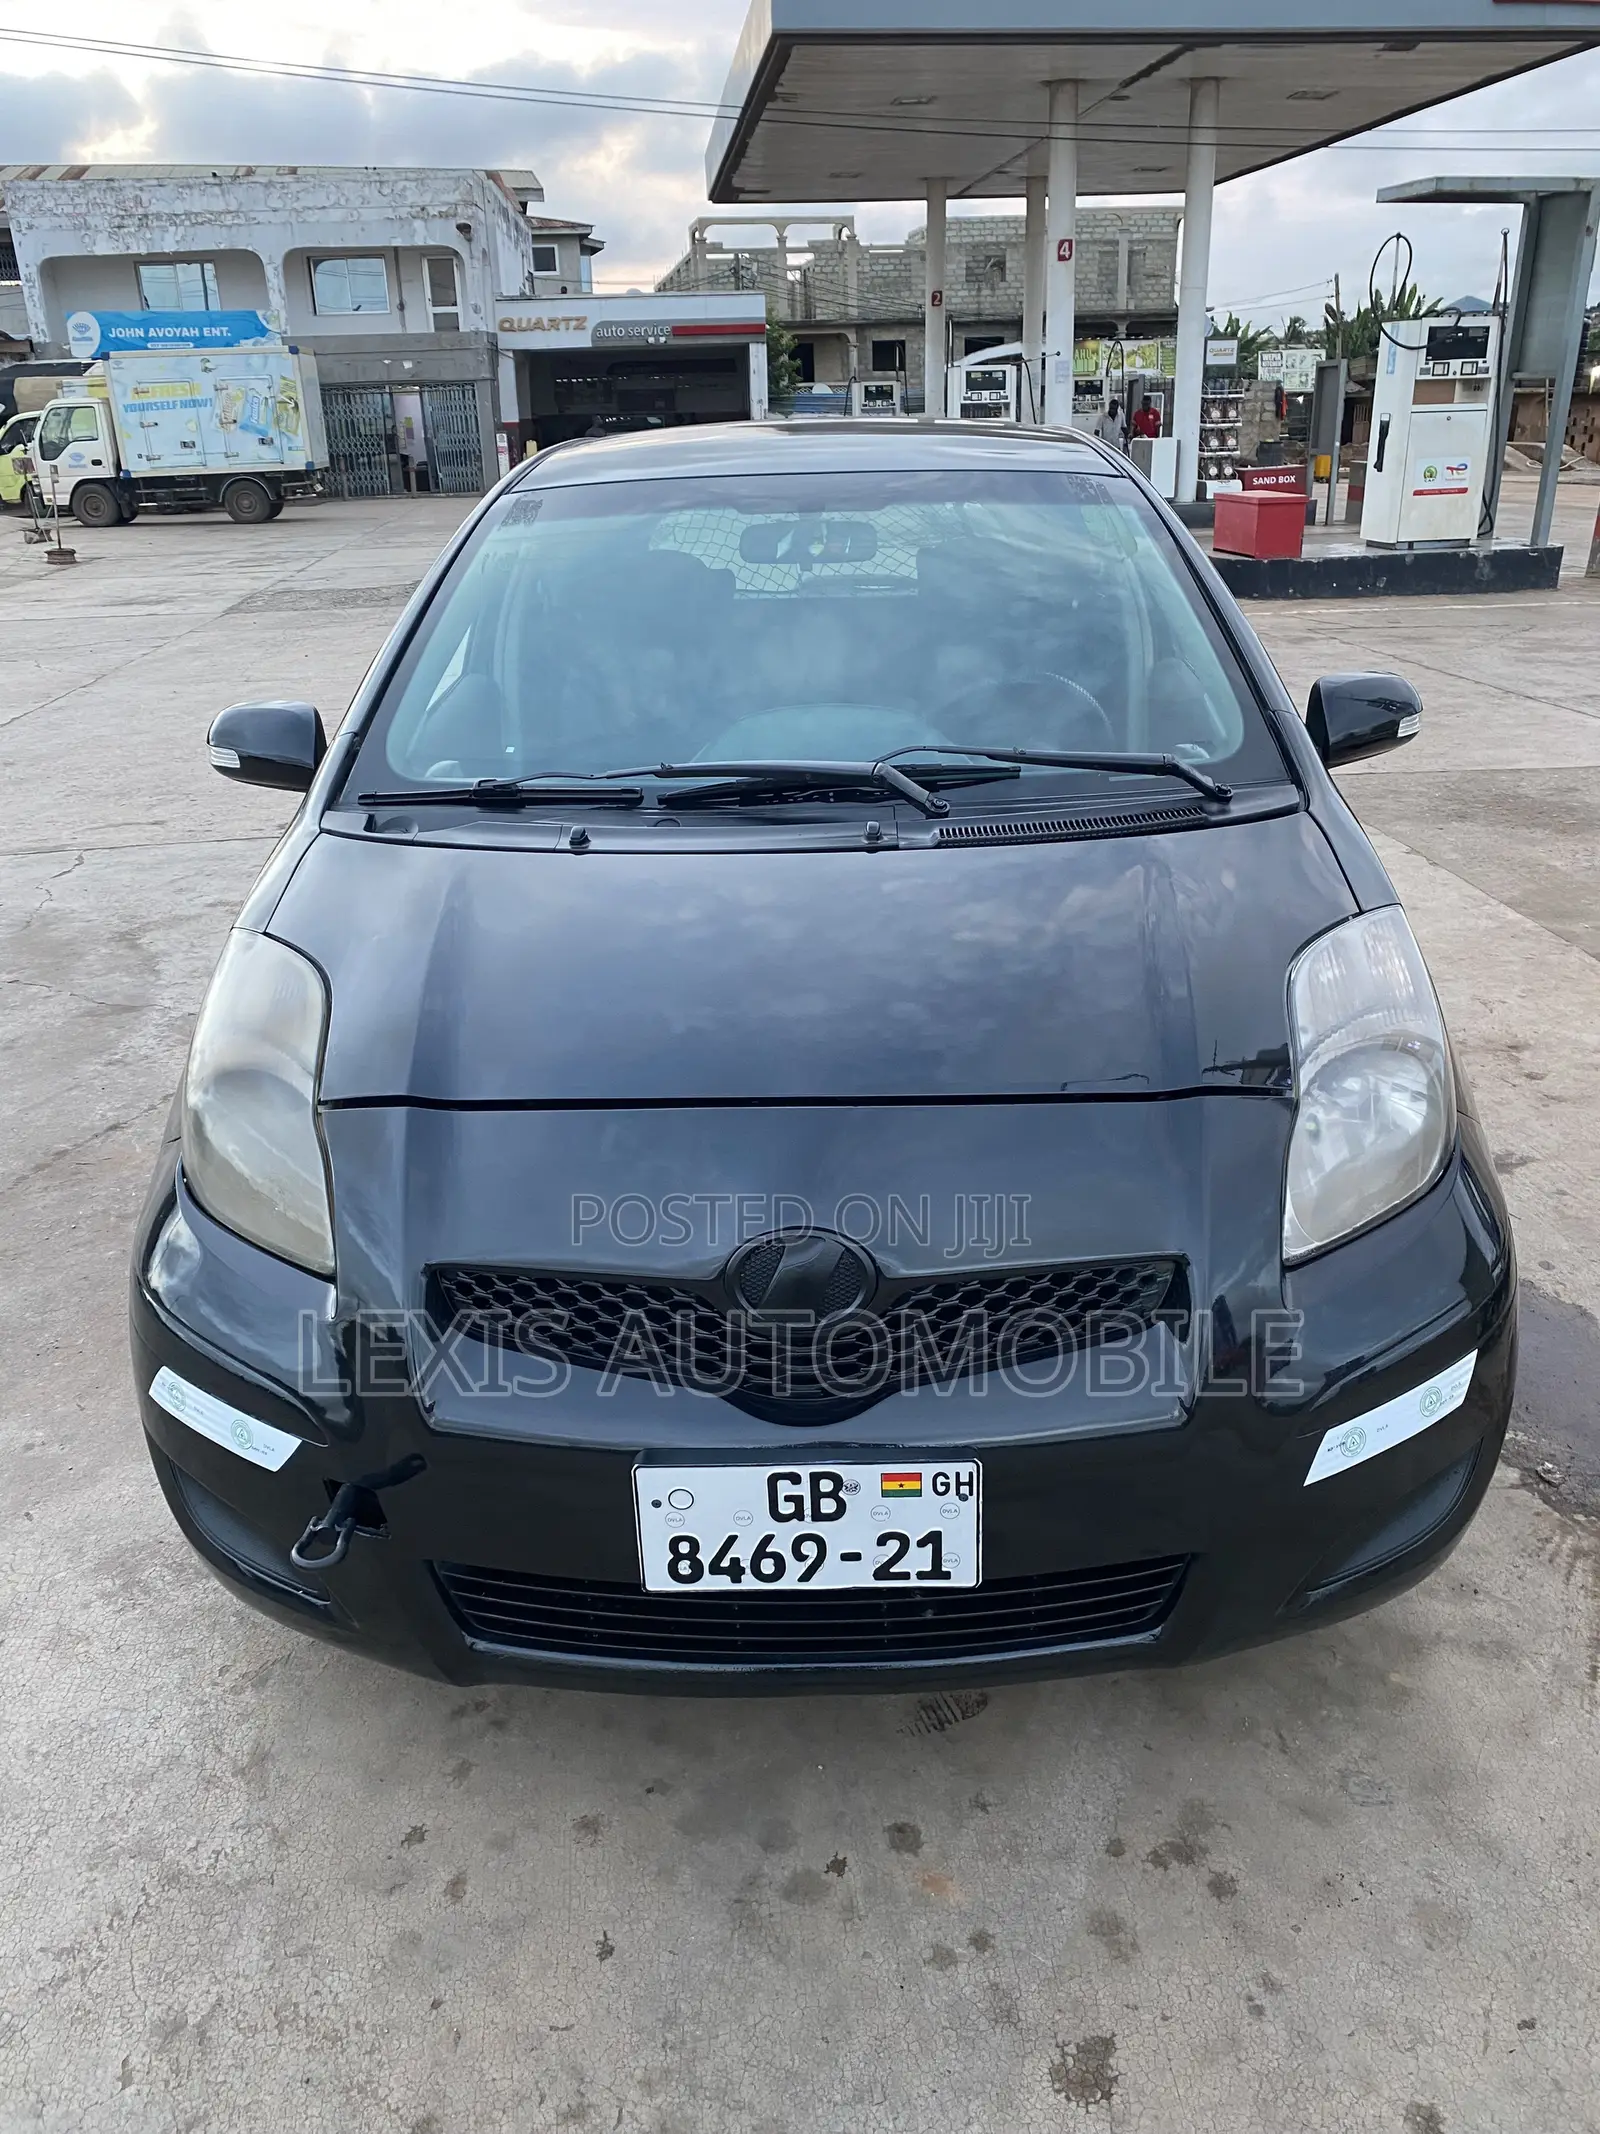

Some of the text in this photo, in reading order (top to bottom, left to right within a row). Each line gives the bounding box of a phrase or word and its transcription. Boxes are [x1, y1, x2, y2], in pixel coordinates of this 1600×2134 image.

[1059, 241, 1071, 258] 4
[933, 293, 941, 305] 2
[498, 315, 588, 332] QUARTZ
[596, 323, 672, 338] auto service
[108, 326, 232, 338] JOHN AVOYAH ENT.
[123, 399, 179, 414] YOURSELF
[1252, 475, 1296, 486] SAND BOX
[931, 1471, 974, 1498] GH
[766, 1470, 847, 1523] GB
[667, 1530, 952, 1584] 8469-21
